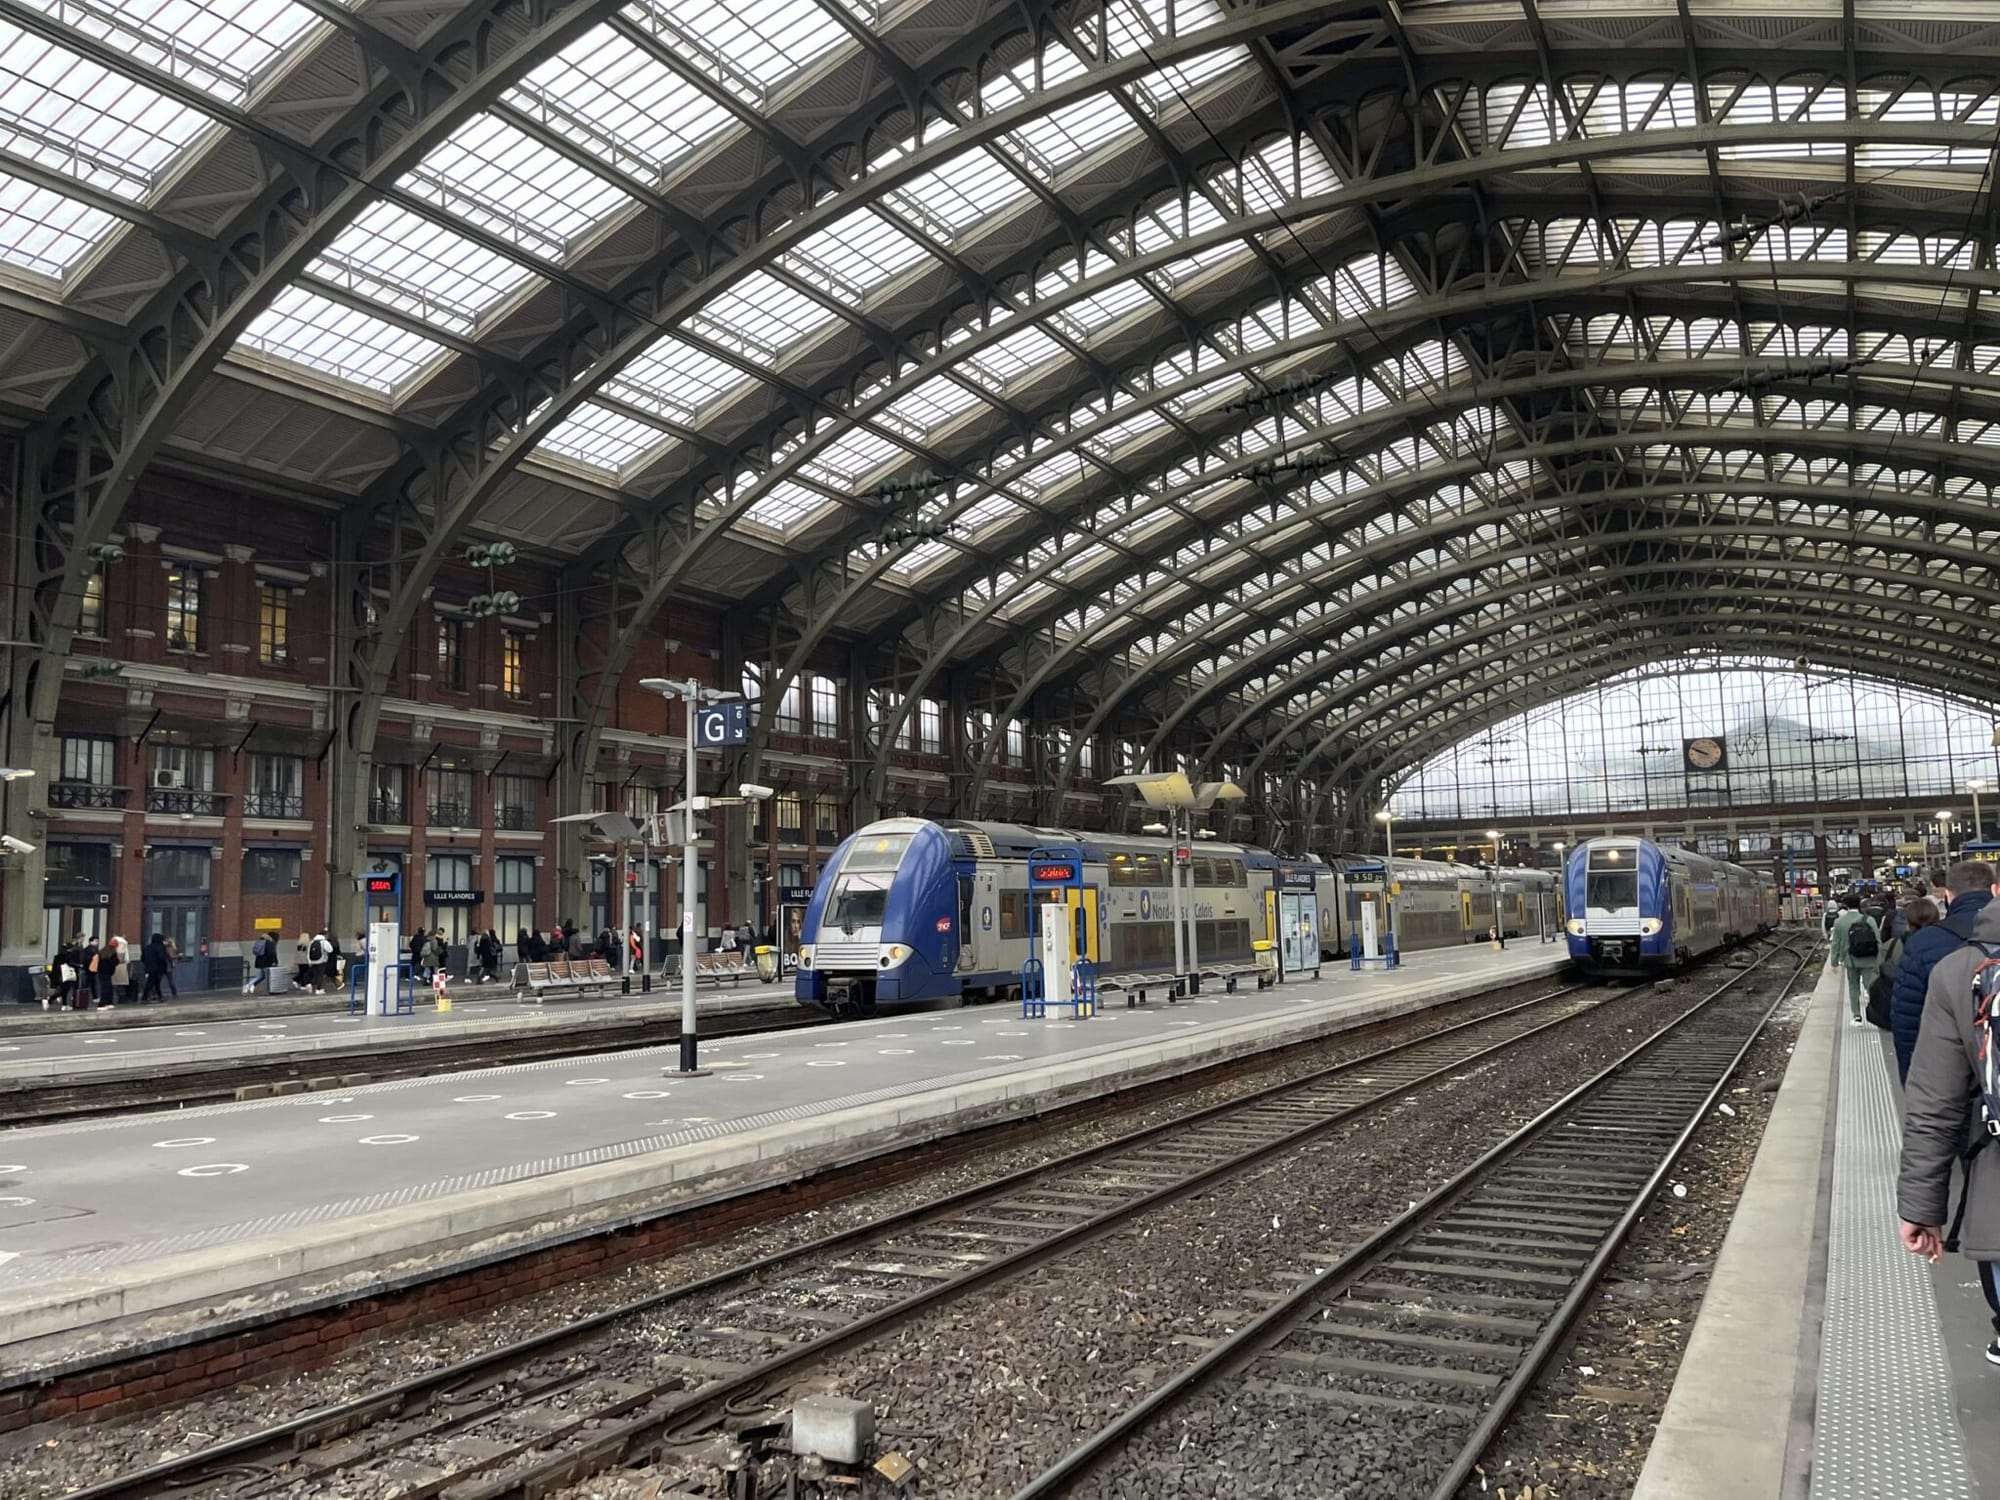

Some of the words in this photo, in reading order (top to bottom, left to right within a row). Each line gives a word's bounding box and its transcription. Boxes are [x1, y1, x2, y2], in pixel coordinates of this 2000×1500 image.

[704, 712, 725, 742] G
[1928, 823, 1939, 834] H
[1951, 822, 1962, 833] H
[1501, 840, 1510, 850] H
[1975, 852, 1982, 861] 9
[1152, 903, 1185, 920] Nord-s
